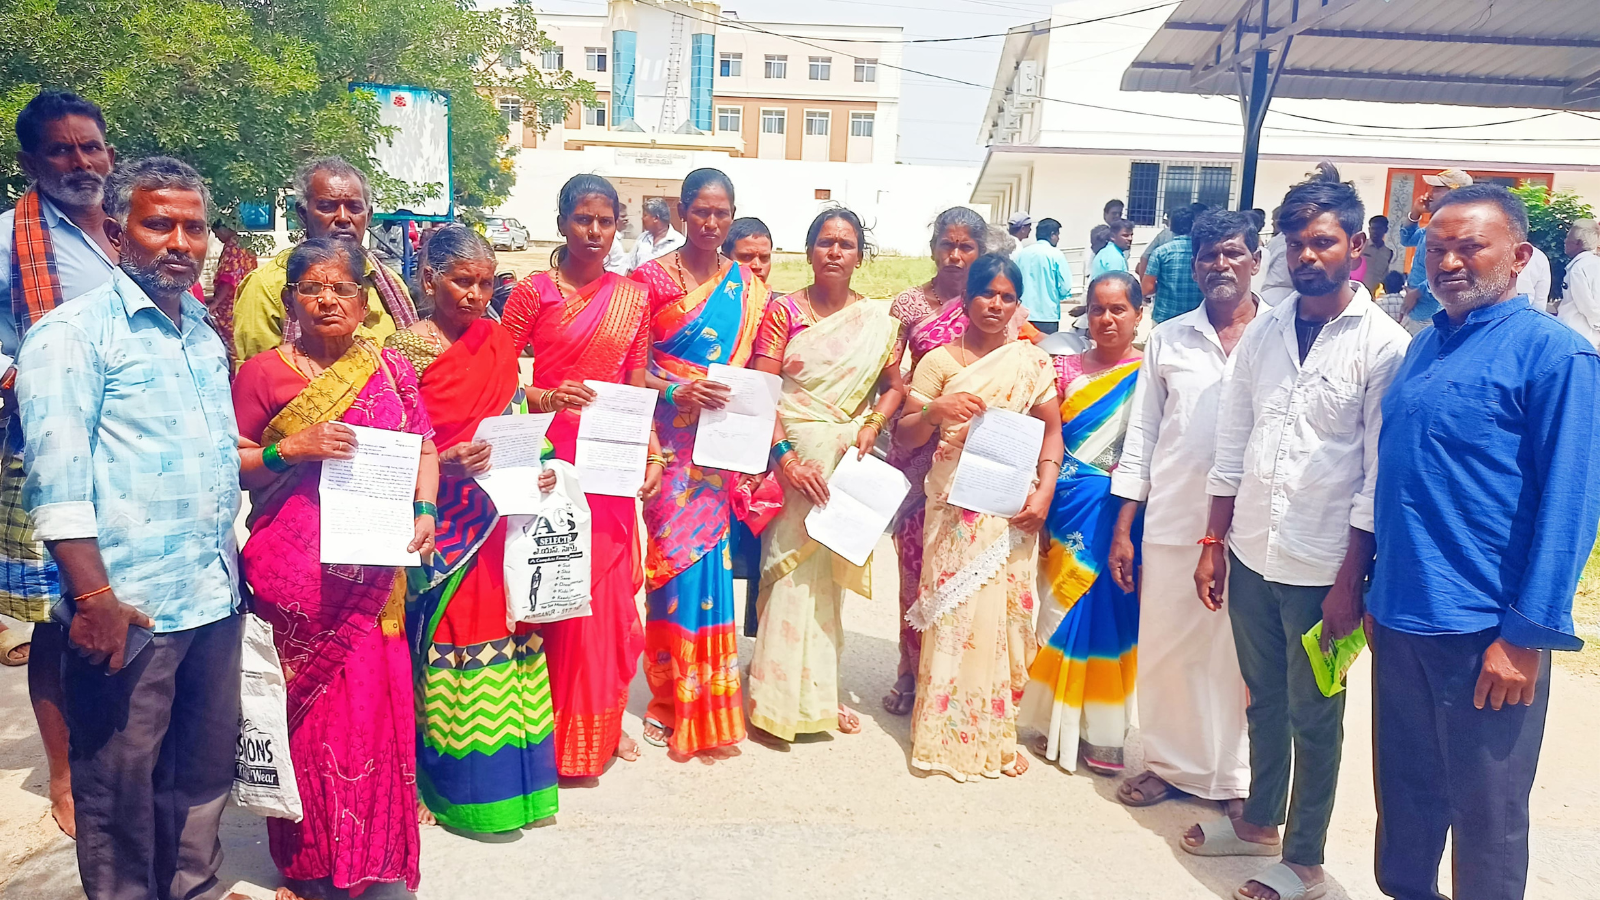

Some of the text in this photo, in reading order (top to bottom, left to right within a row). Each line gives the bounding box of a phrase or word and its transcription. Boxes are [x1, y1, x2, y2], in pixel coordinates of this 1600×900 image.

[532, 516, 556, 536] A
[235, 733, 274, 764] SIONS
[251, 769, 277, 784] Wear
